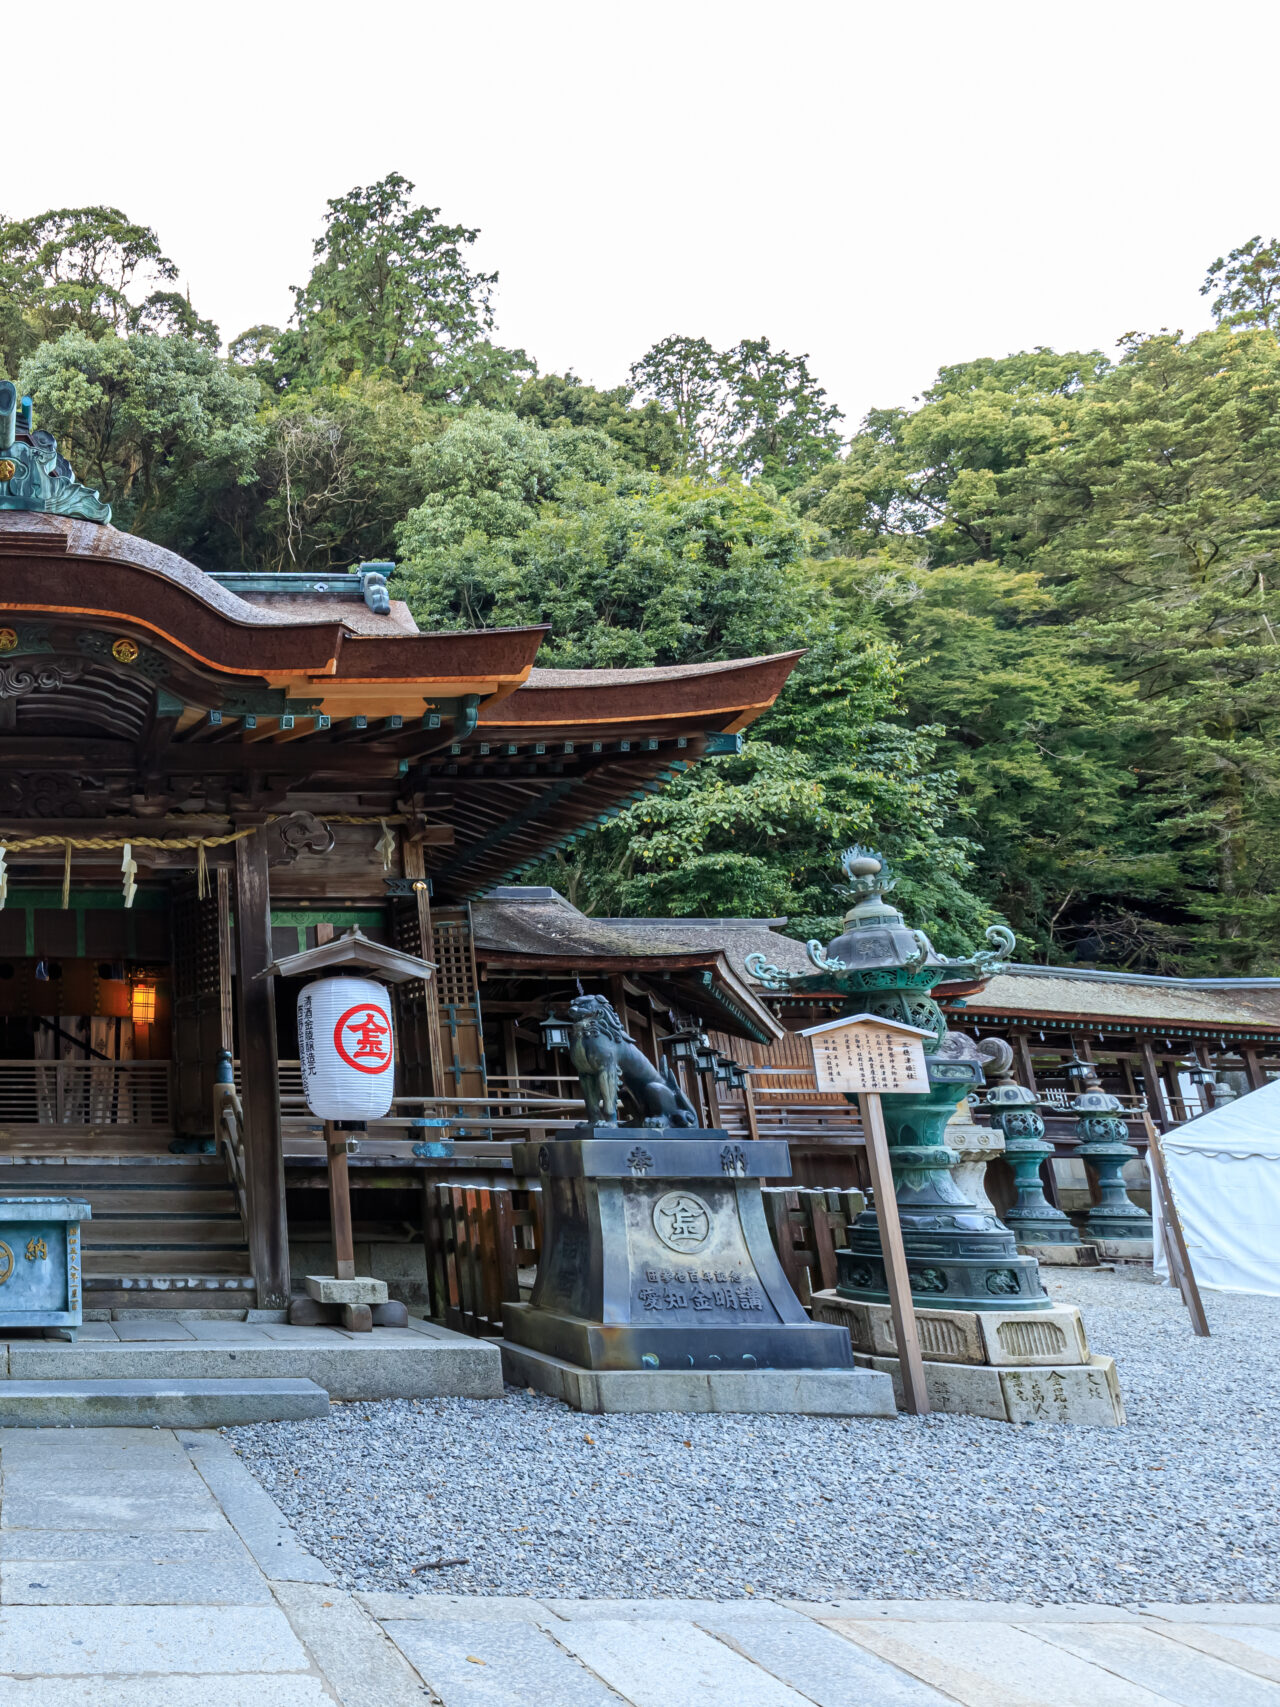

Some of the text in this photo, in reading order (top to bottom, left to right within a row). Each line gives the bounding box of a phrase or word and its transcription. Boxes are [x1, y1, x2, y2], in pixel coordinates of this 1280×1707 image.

[346, 1013, 388, 1061] 金
[626, 1145, 747, 1173] 奉 納
[25, 1237, 48, 1261] 納
[638, 1287, 763, 1311] 愛知金明講
